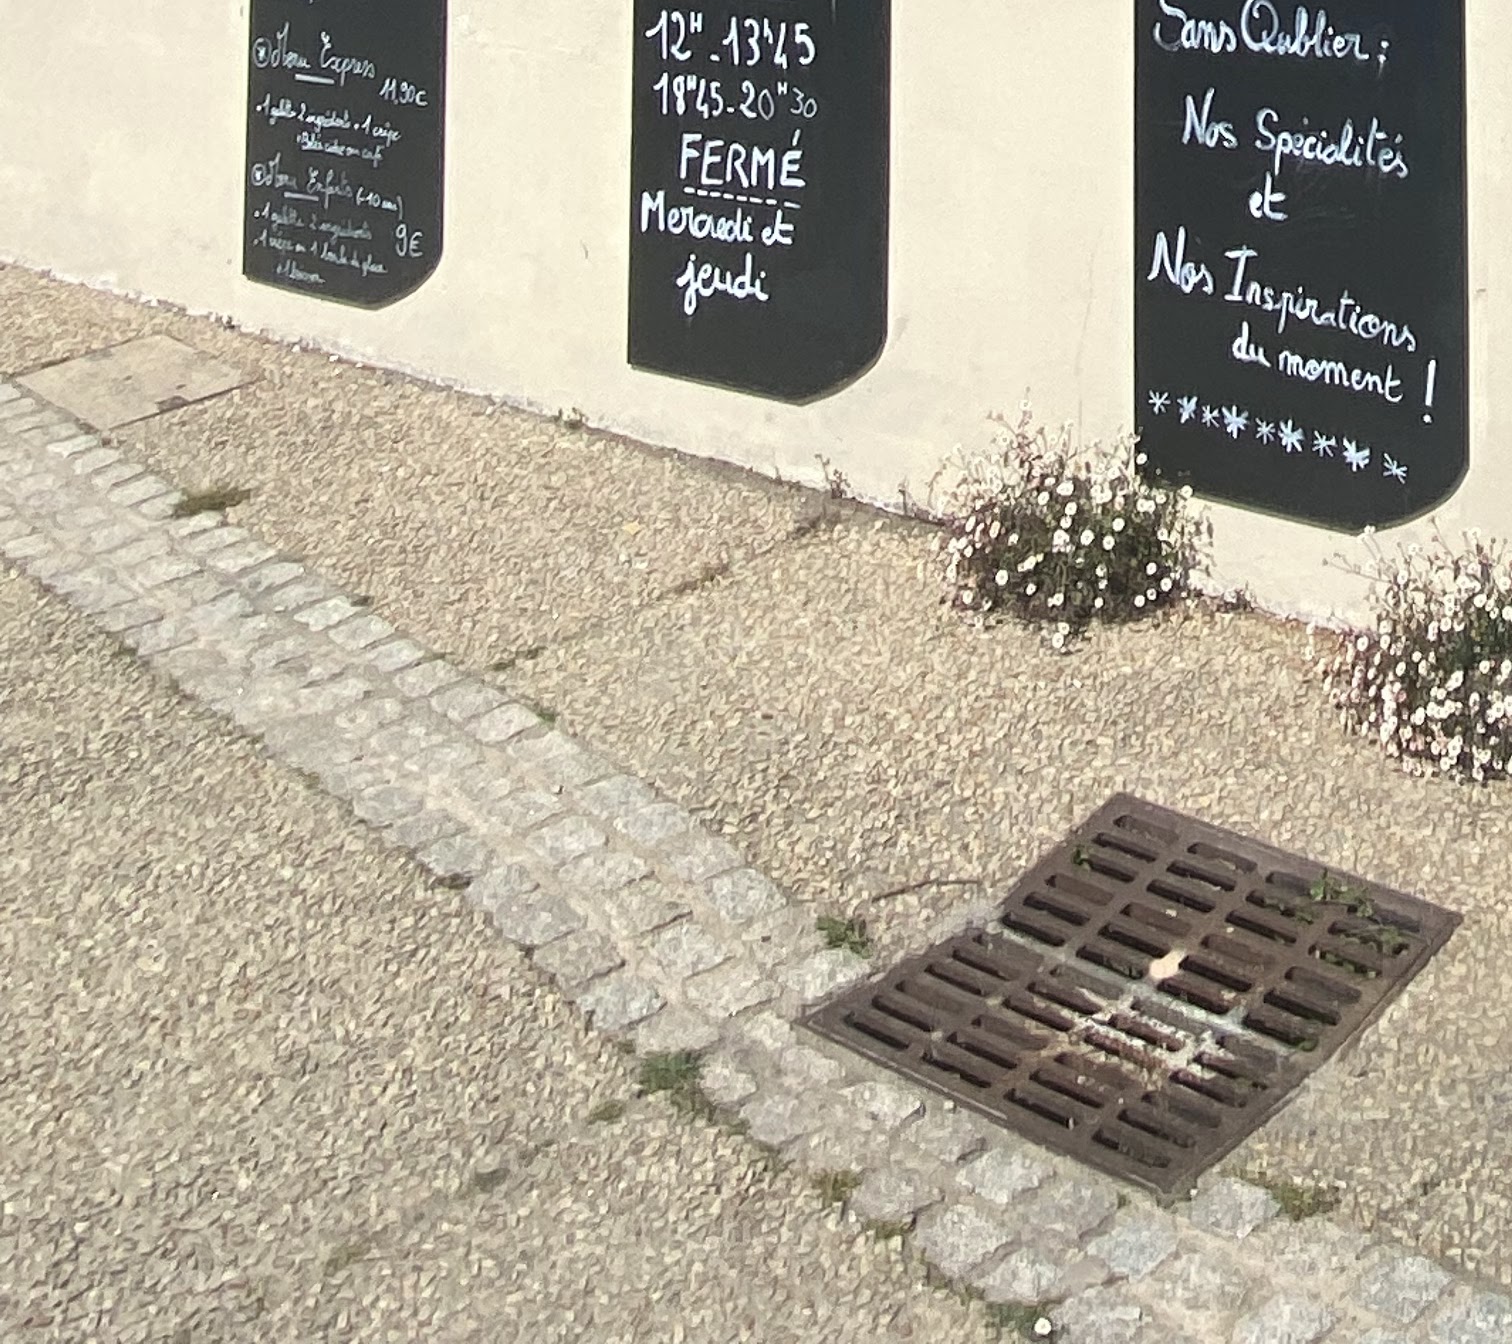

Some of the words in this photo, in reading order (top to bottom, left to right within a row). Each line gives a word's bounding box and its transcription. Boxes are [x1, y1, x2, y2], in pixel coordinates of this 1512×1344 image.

[1181, 88, 1238, 150] Nos
[678, 128, 806, 189] FERMÉ
[640, 191, 754, 244] Mercredi
[760, 209, 795, 246] et
[1248, 172, 1289, 222] et
[395, 223, 424, 258] 9€
[676, 252, 770, 316] jeudi
[1147, 226, 1216, 294] Nos
[1223, 244, 1417, 354] Inspirations
[1231, 321, 1271, 365] du
[1278, 347, 1404, 404] moment
